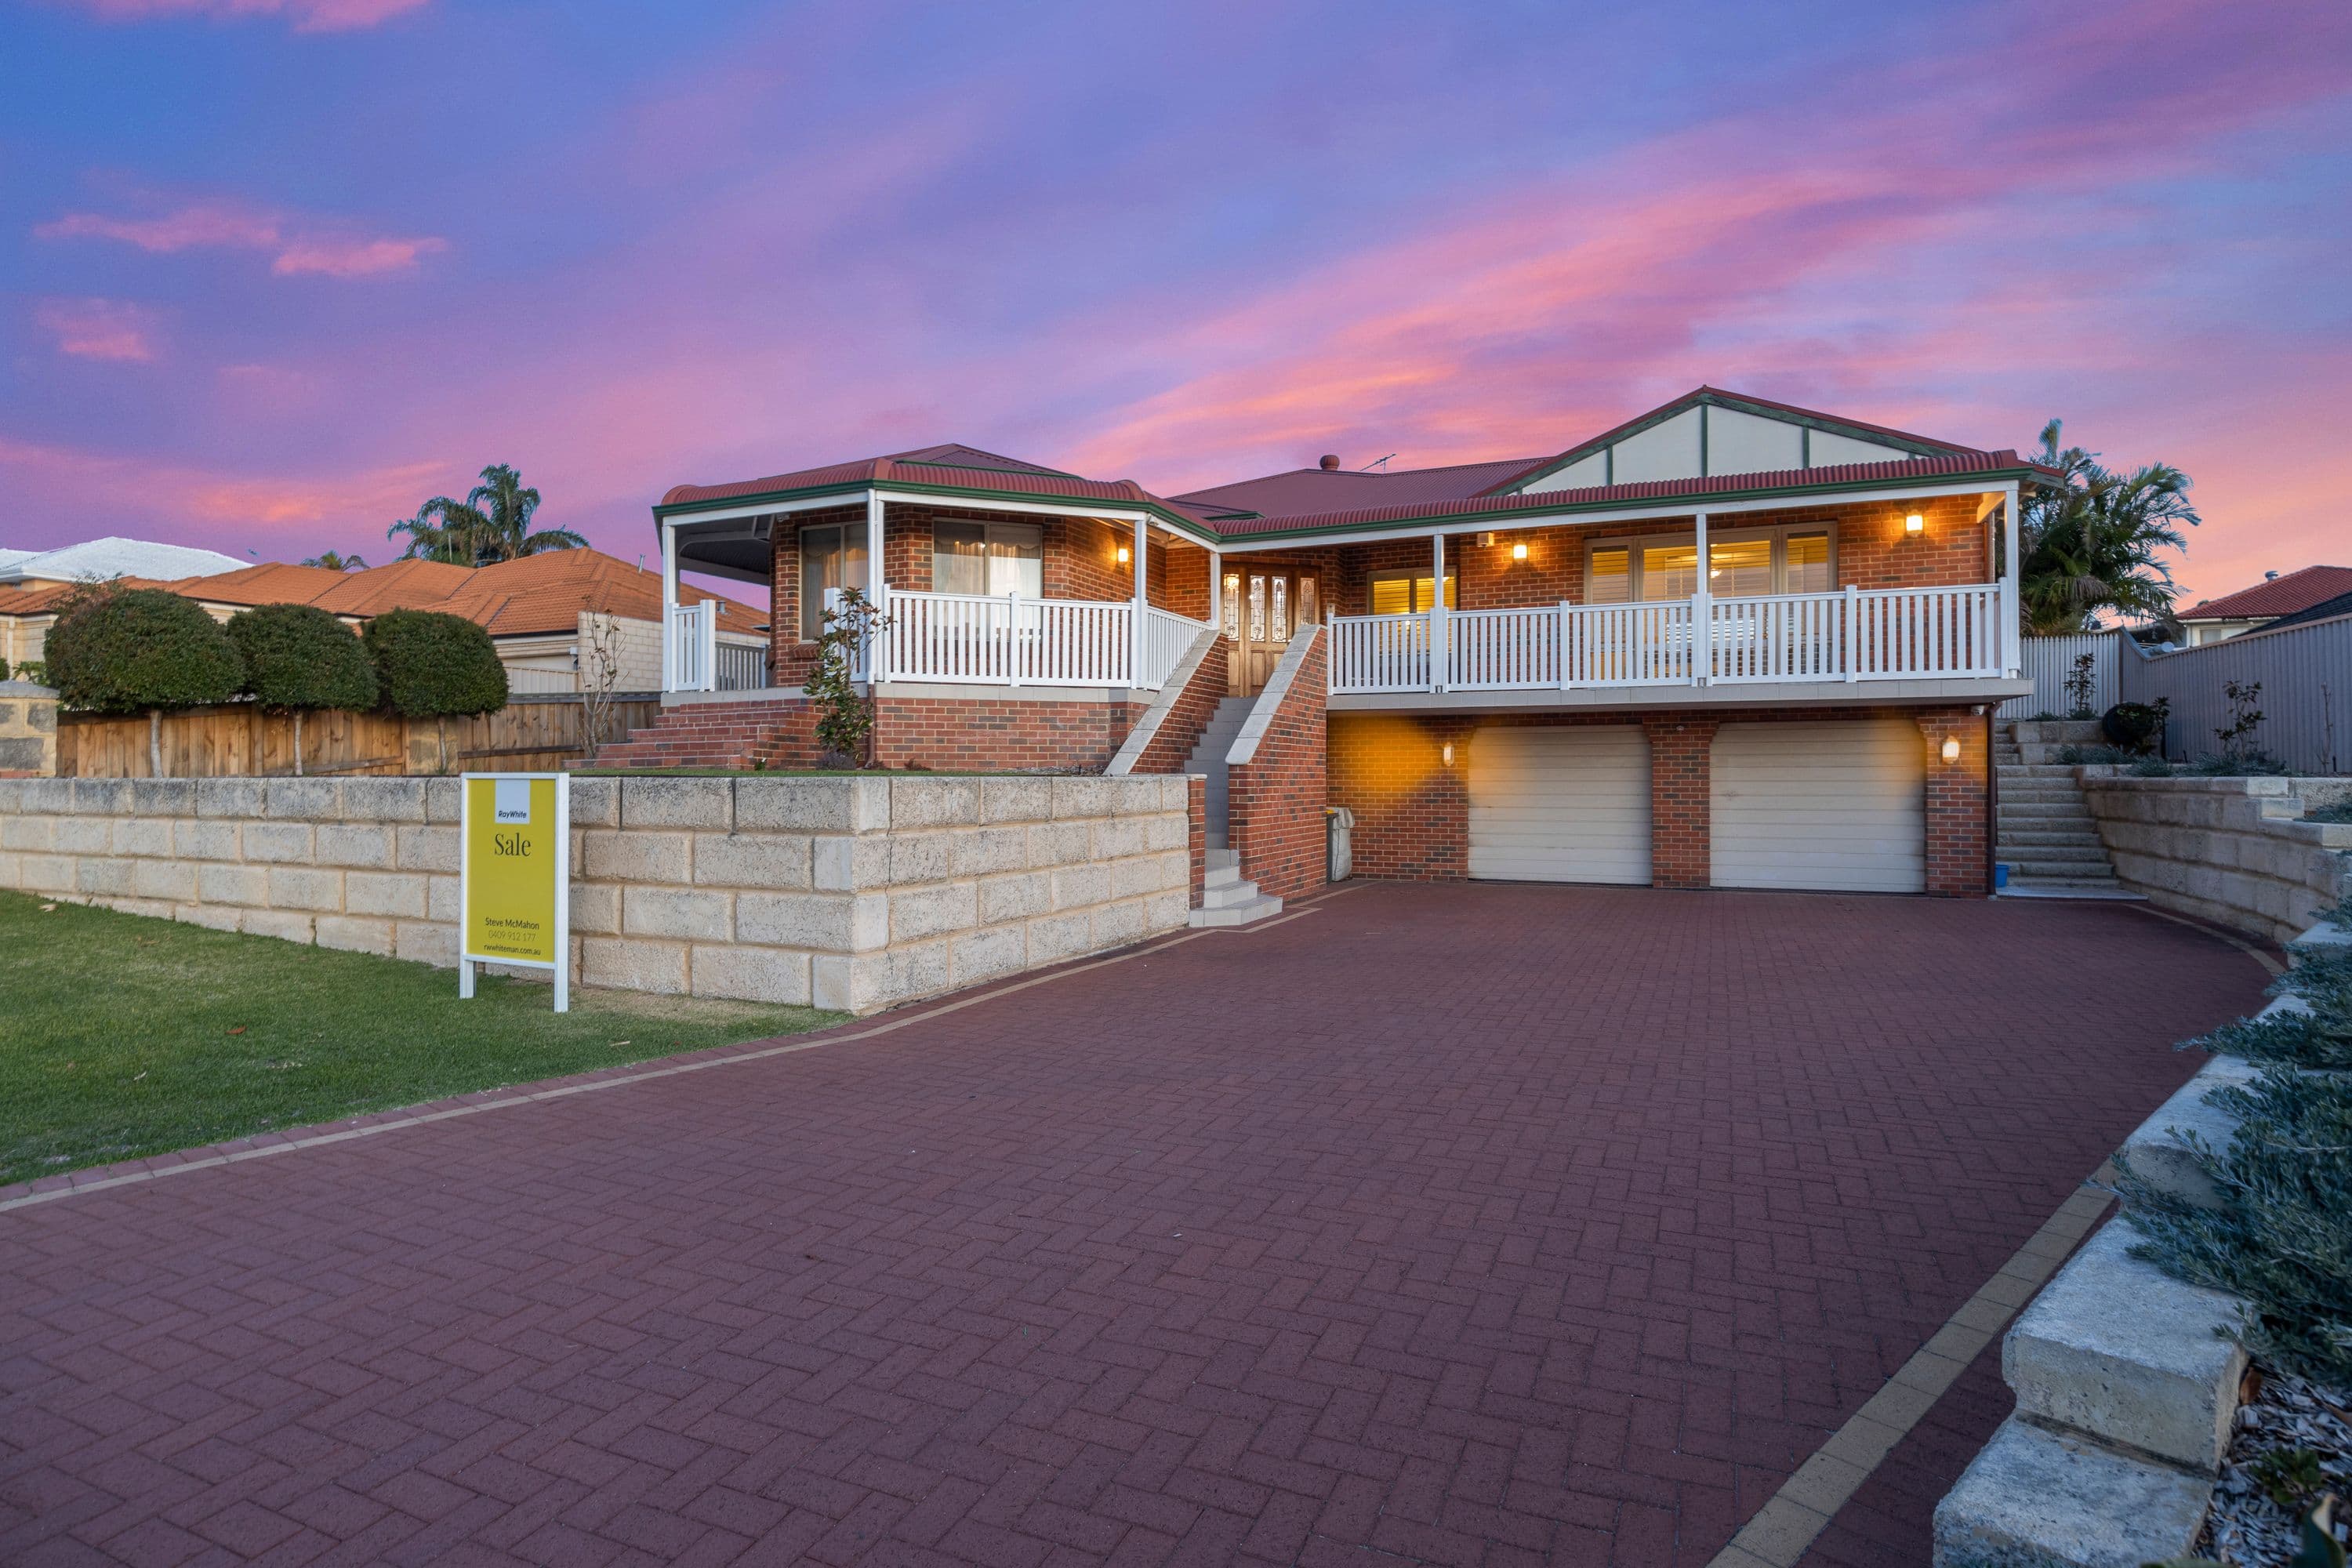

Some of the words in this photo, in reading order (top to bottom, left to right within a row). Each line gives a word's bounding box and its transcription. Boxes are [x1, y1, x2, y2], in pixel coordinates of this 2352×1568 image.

[495, 832, 532, 857] Sale
[485, 917, 503, 927] Steve
[505, 919, 540, 931] McMahon
[488, 930, 506, 939] 0409
[507, 931, 521, 942] 912
[522, 933, 536, 942] 177
